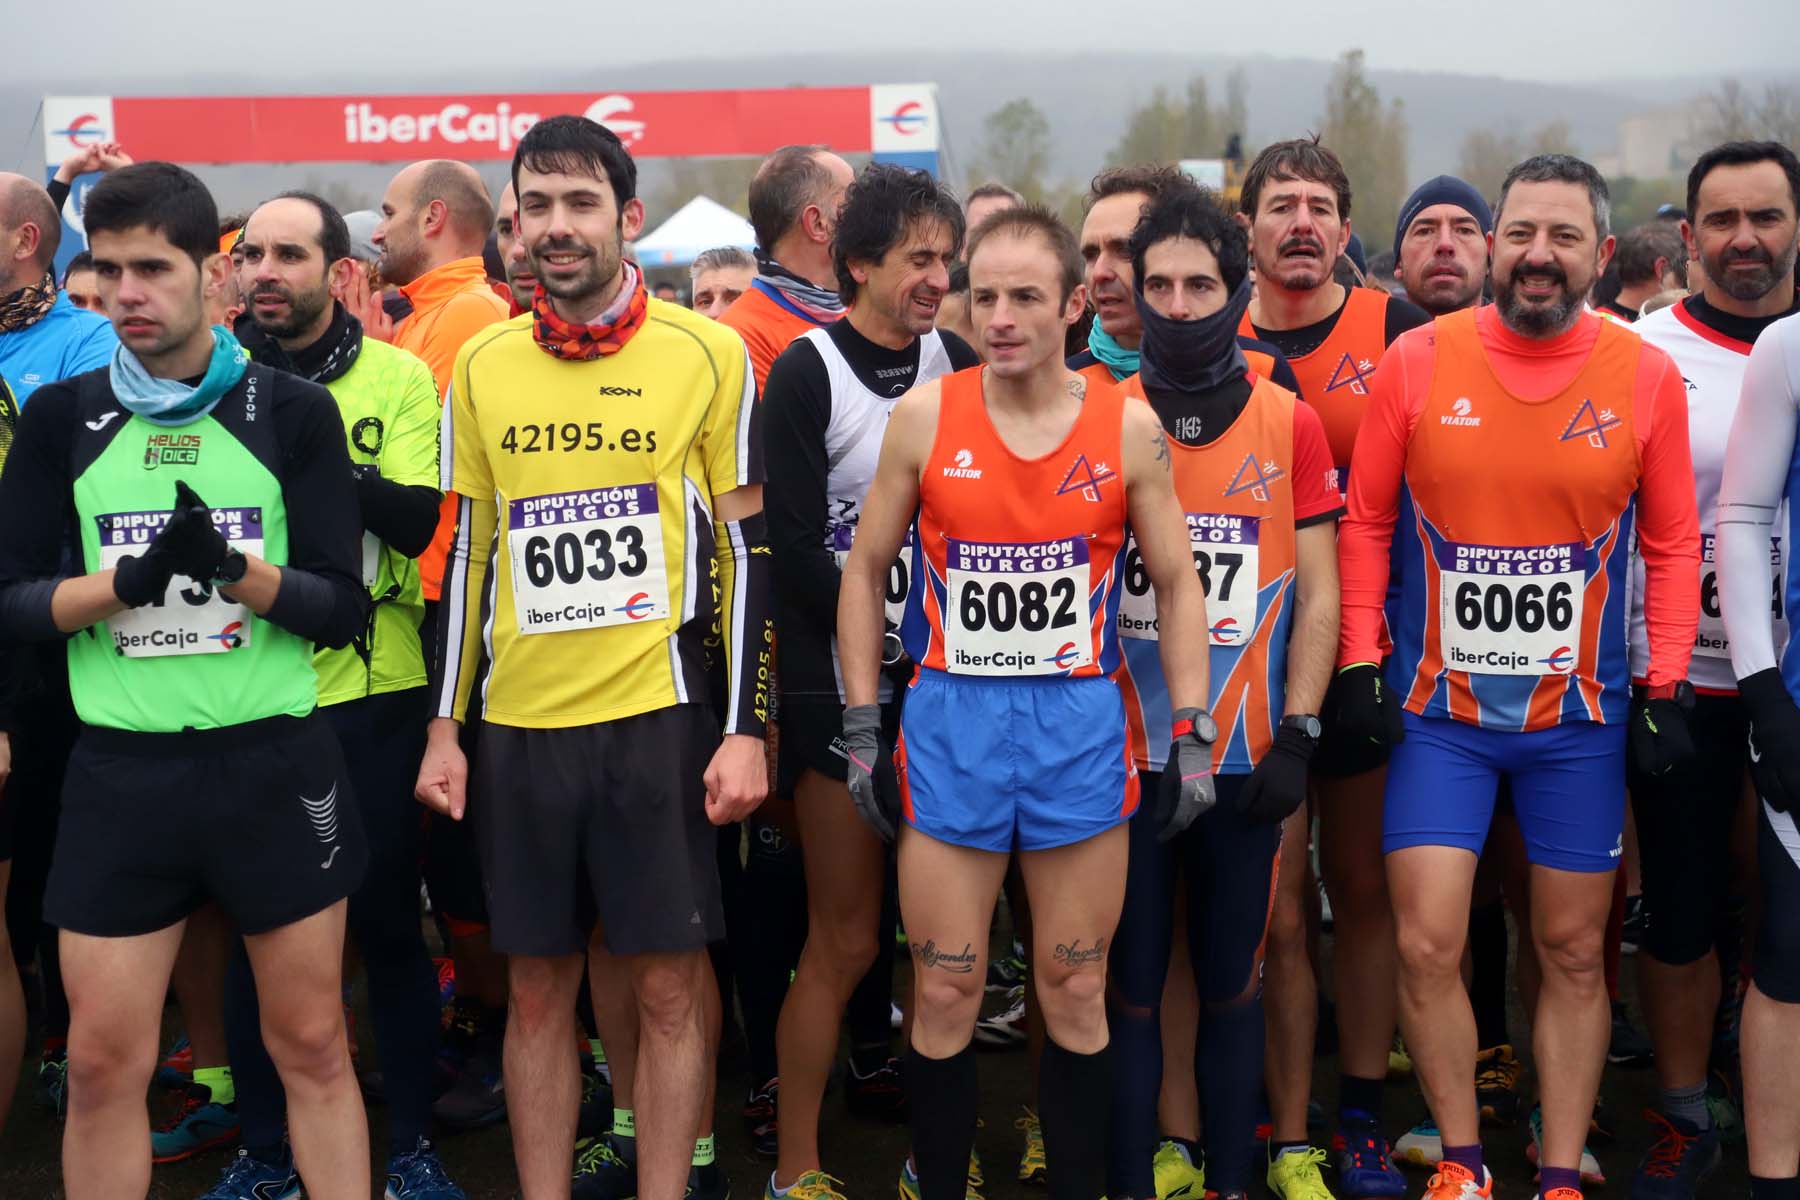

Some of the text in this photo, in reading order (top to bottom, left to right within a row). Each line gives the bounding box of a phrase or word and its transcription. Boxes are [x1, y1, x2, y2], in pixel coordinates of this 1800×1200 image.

[344, 102, 541, 151] iberCaja
[246, 377, 257, 421] CAYON
[1440, 415, 1481, 426] VIATOR
[501, 423, 656, 454] 42195.es
[943, 467, 982, 479] VIATOR
[523, 486, 638, 513] DIPUTACIÓN
[523, 502, 640, 528] BURGOS
[525, 525, 648, 588] 6033
[960, 541, 1073, 558] DIPUTACIÓN
[1456, 545, 1571, 561] DIPUTACIÓN
[960, 554, 1074, 572] BURGOS
[1456, 559, 1571, 575] BURGOS
[527, 603, 606, 625] iberCaja
[960, 577, 1077, 633] 6082
[1455, 581, 1573, 633] 6066
[114, 628, 198, 649] iberCaja
[955, 650, 1036, 670] iberCaja
[1451, 647, 1529, 670] iberCaja
[753, 619, 775, 724] 42195.es
